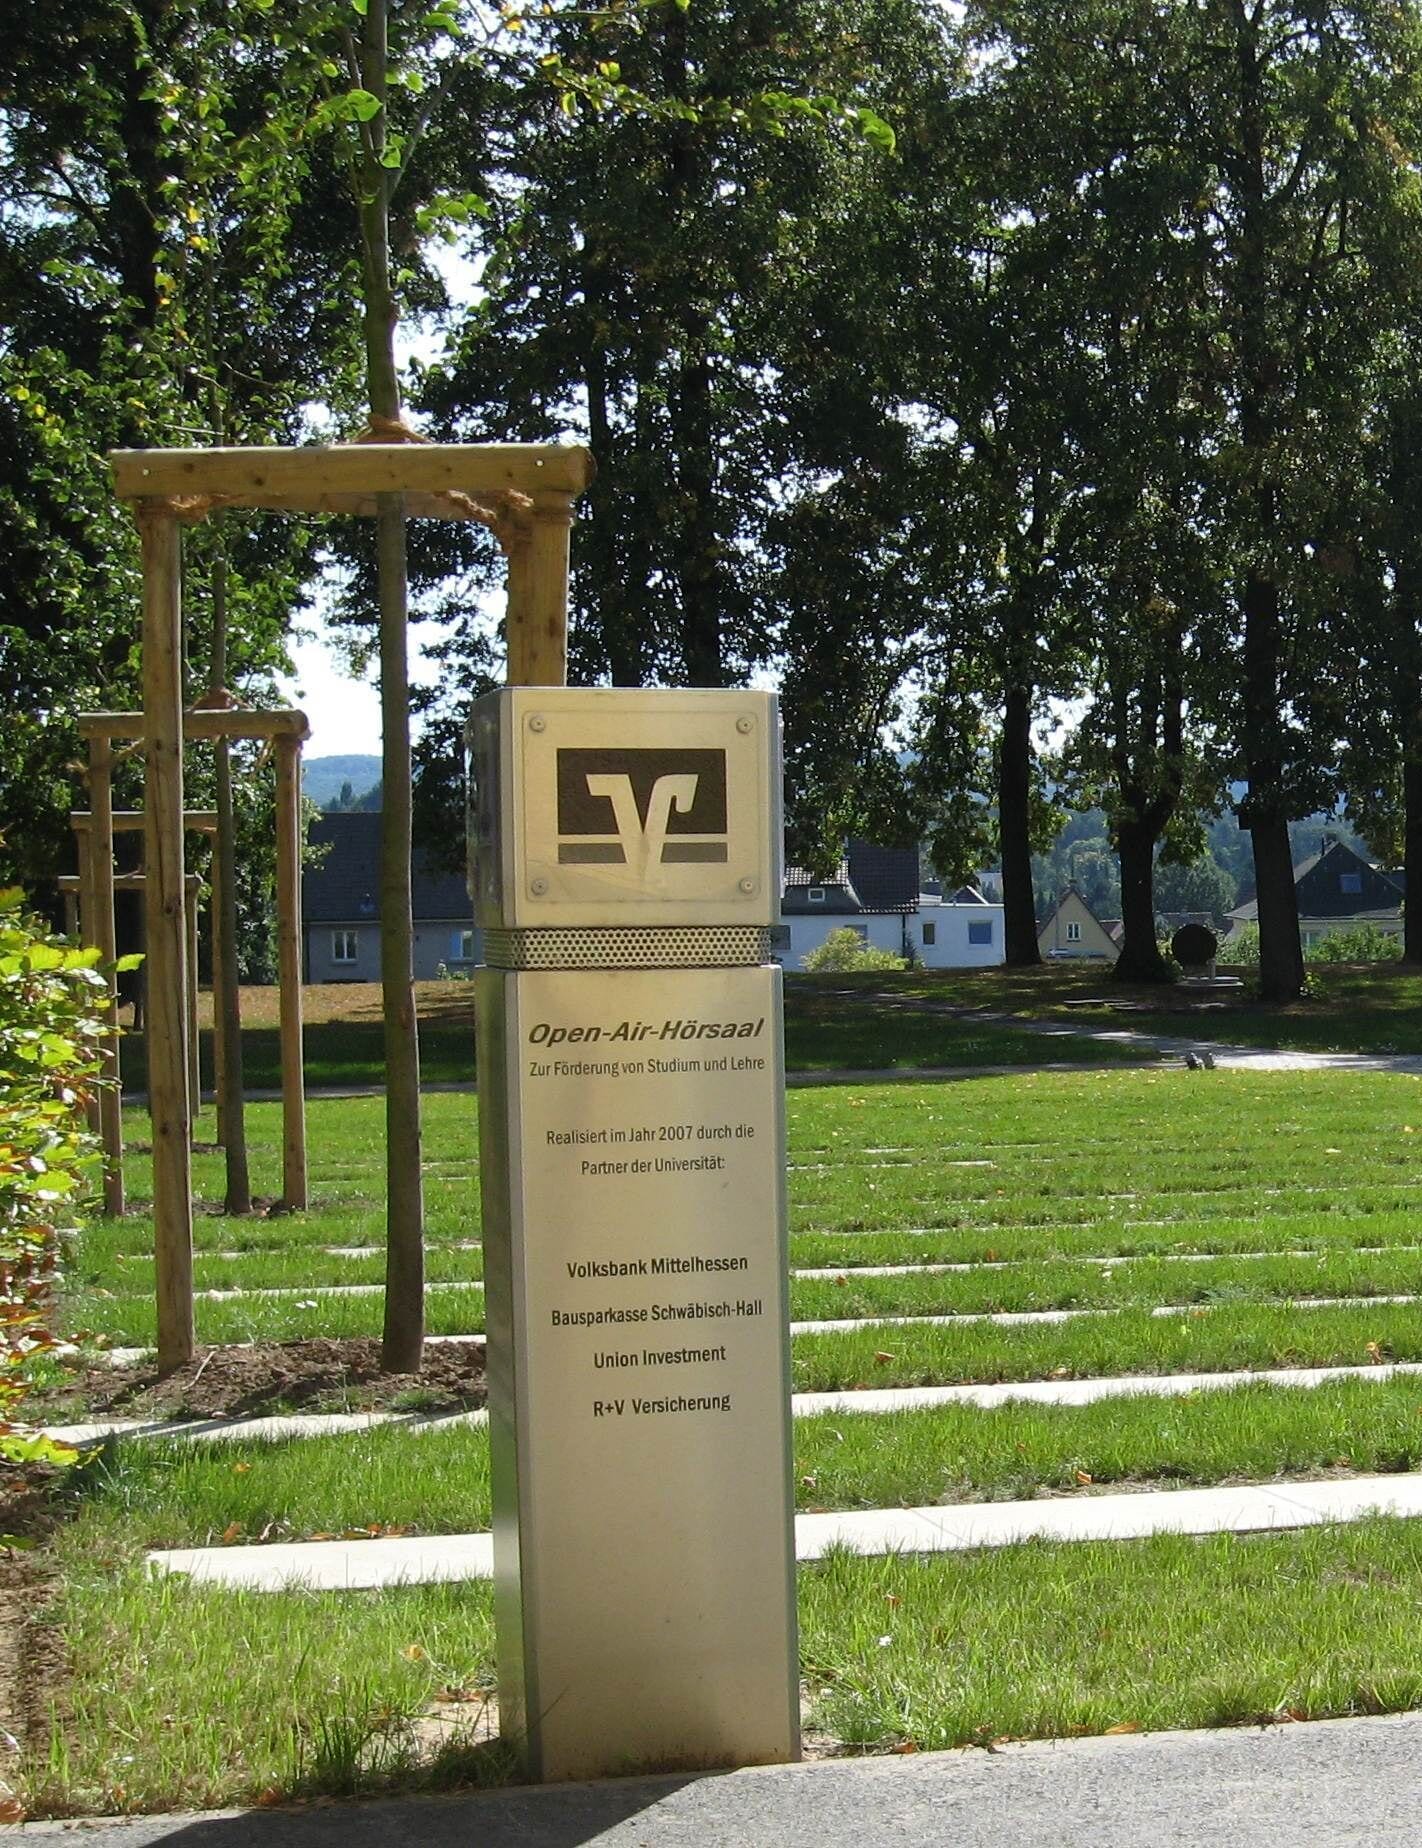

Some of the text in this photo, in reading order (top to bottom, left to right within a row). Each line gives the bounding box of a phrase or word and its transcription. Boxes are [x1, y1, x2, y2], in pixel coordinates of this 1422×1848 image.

[529, 1018, 764, 1047] Open-Air-Hörsaal
[530, 1056, 764, 1077] Zur Förderung von Studium und Lehre
[547, 1124, 754, 1144] Realisiert im Jahr 2007 durch die
[582, 1156, 725, 1175] Partner der Universität:
[567, 1256, 747, 1278] Volksbank Mittelhessen
[552, 1300, 762, 1327] Bausparkasse Schwäbisch-Hall
[594, 1346, 726, 1368] Union Investment
[594, 1395, 731, 1417] R+V Versicherung
